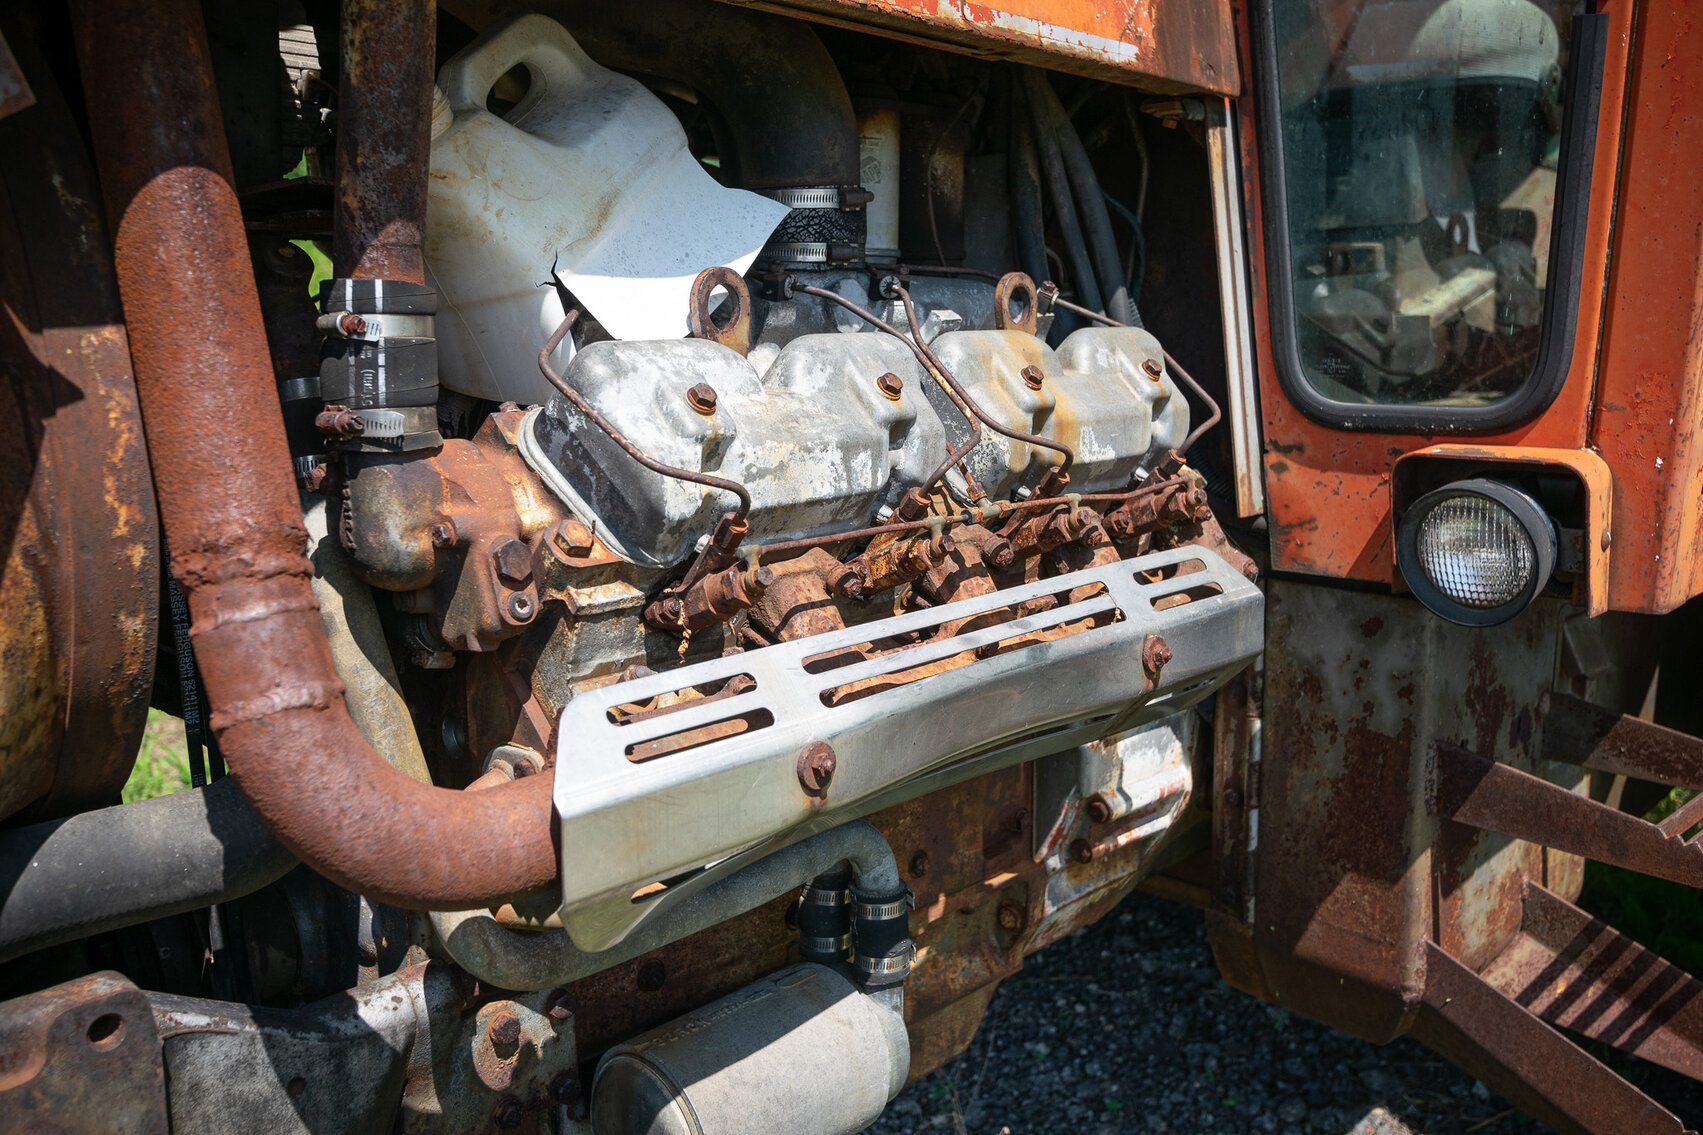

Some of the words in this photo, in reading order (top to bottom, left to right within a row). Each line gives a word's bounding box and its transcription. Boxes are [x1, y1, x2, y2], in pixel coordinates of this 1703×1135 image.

[168, 580, 179, 621] MASSEY
[176, 590, 188, 621] ASSEY
[180, 623, 195, 677] FERGUSON
